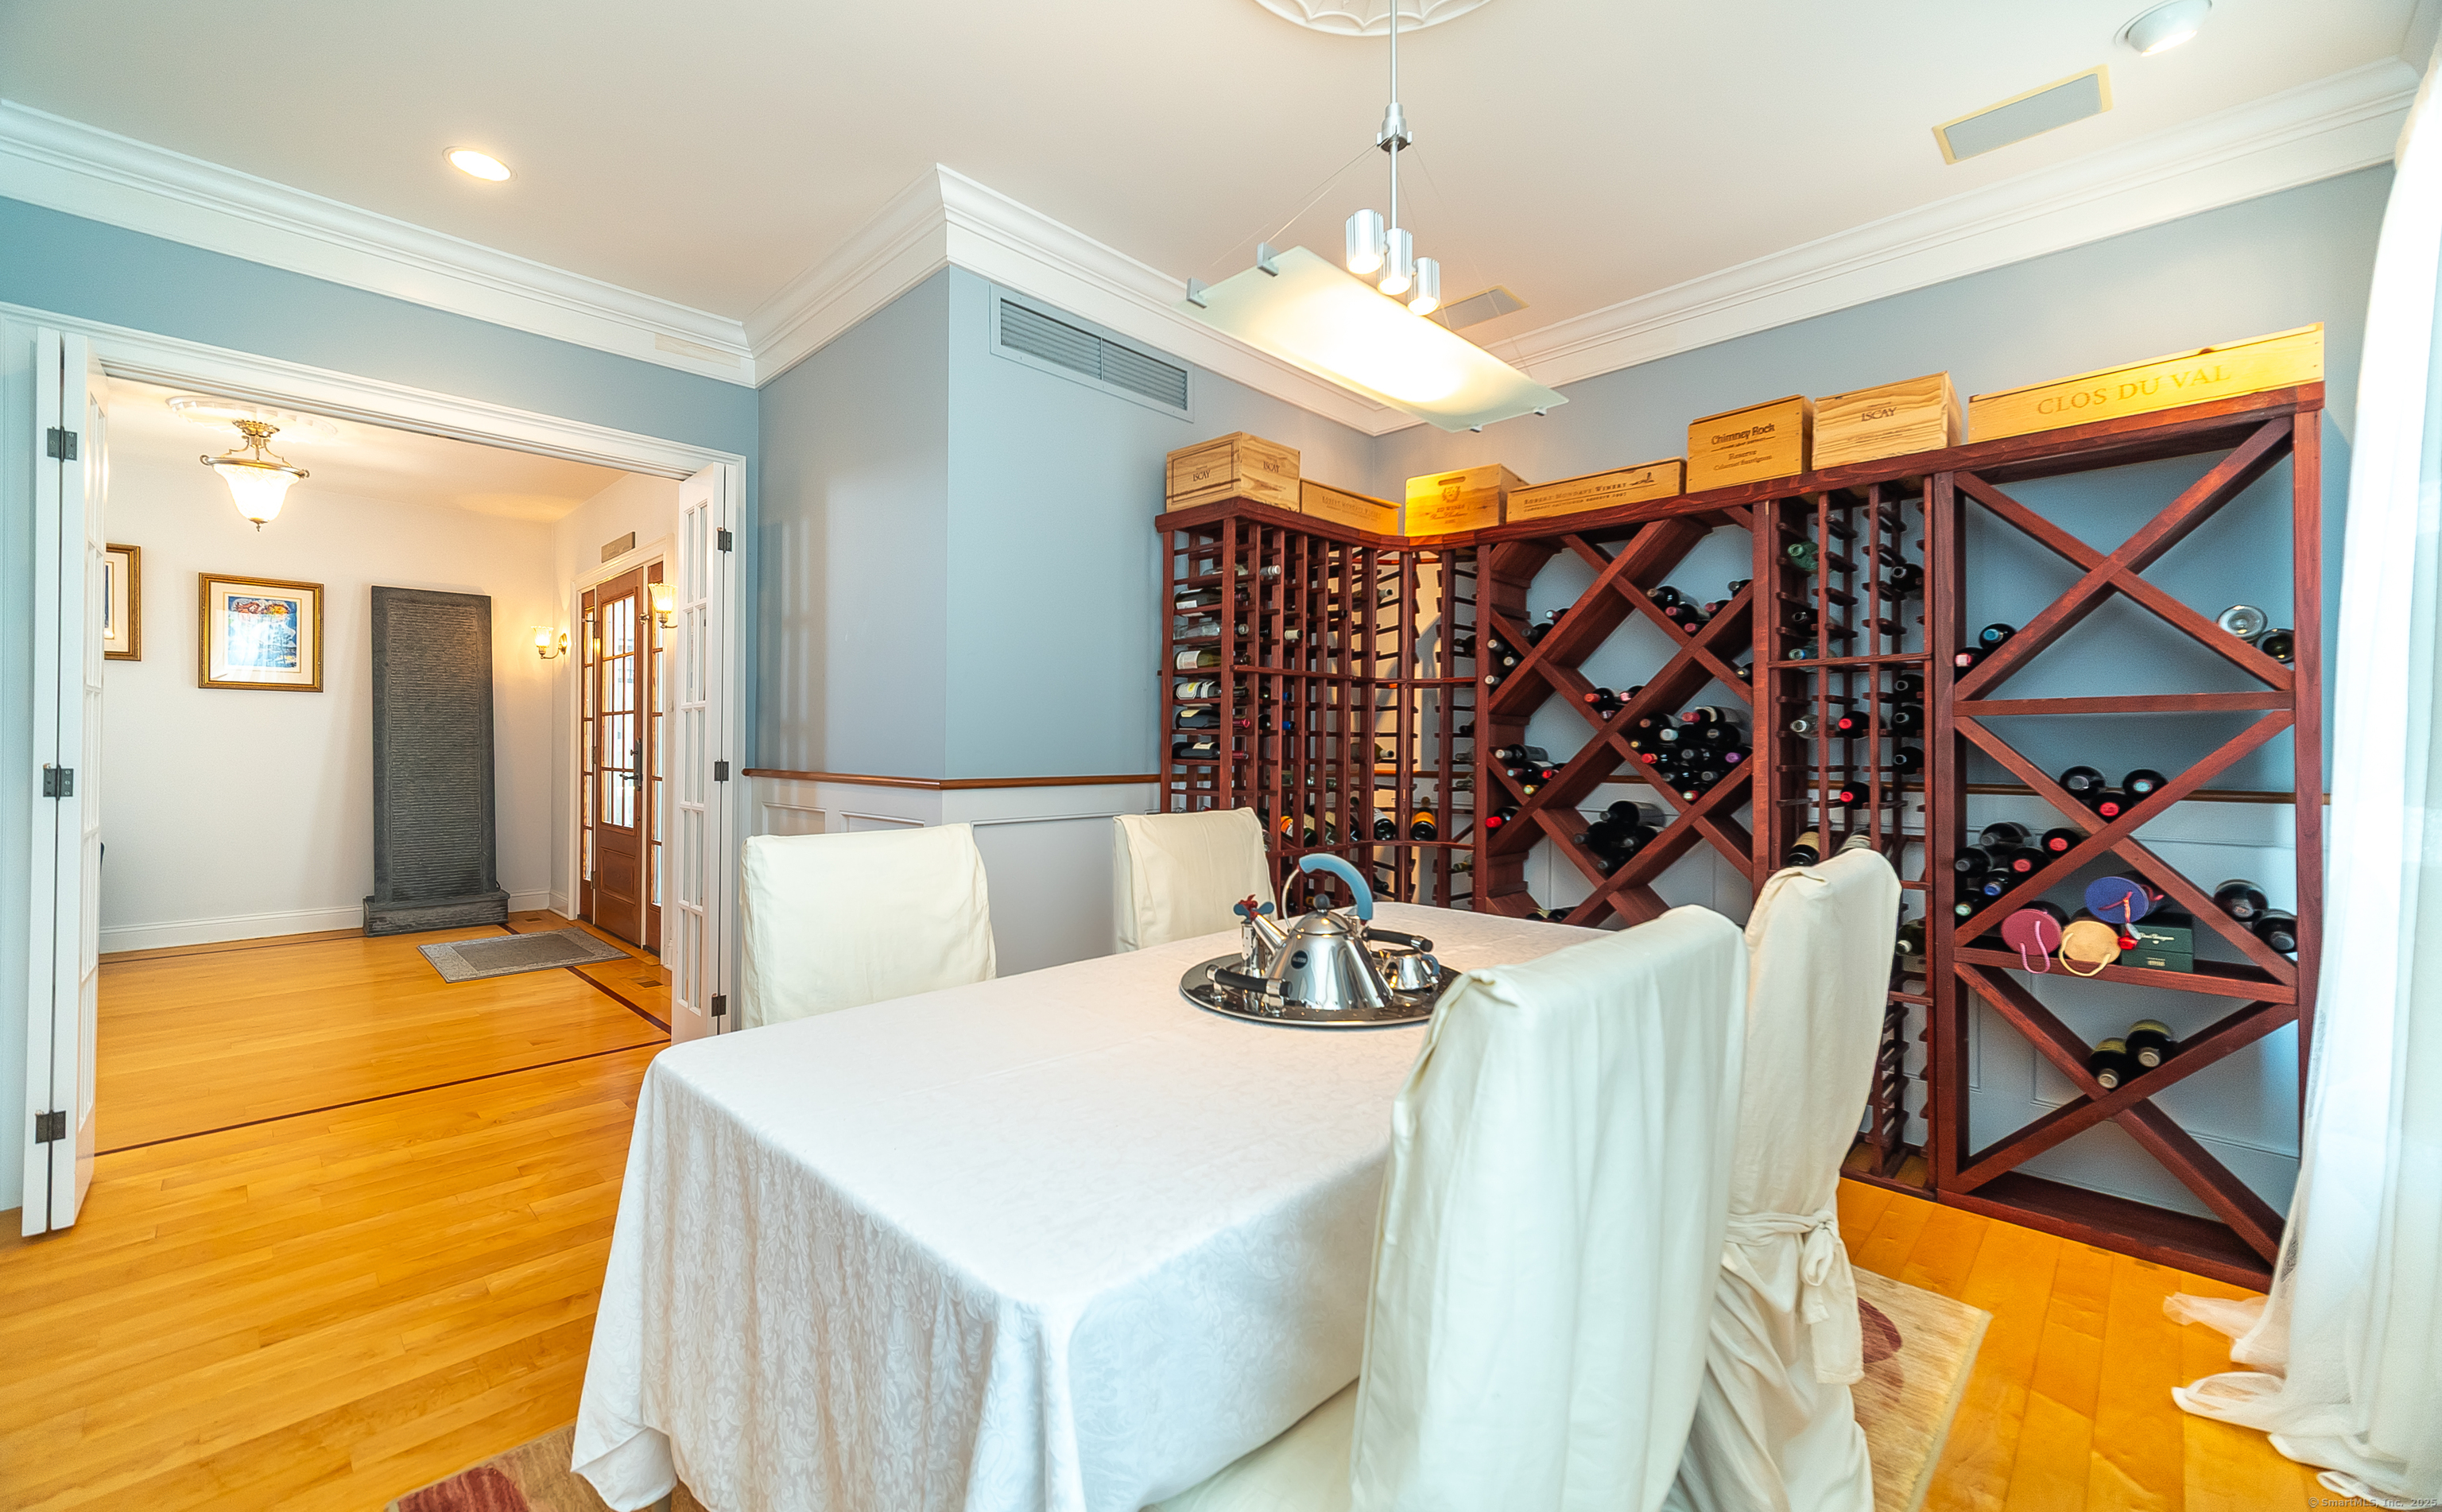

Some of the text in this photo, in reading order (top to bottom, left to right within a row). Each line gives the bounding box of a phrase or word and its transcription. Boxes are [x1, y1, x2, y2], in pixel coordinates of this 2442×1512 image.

[2037, 365, 2231, 415] CLOS DU VAL
[1861, 407, 1897, 421] ISCAY
[1711, 430, 1751, 444] Chimney
[1752, 423, 1775, 436] Rock
[1263, 461, 1281, 474] ISCAY
[1192, 470, 1211, 482] ISCAY
